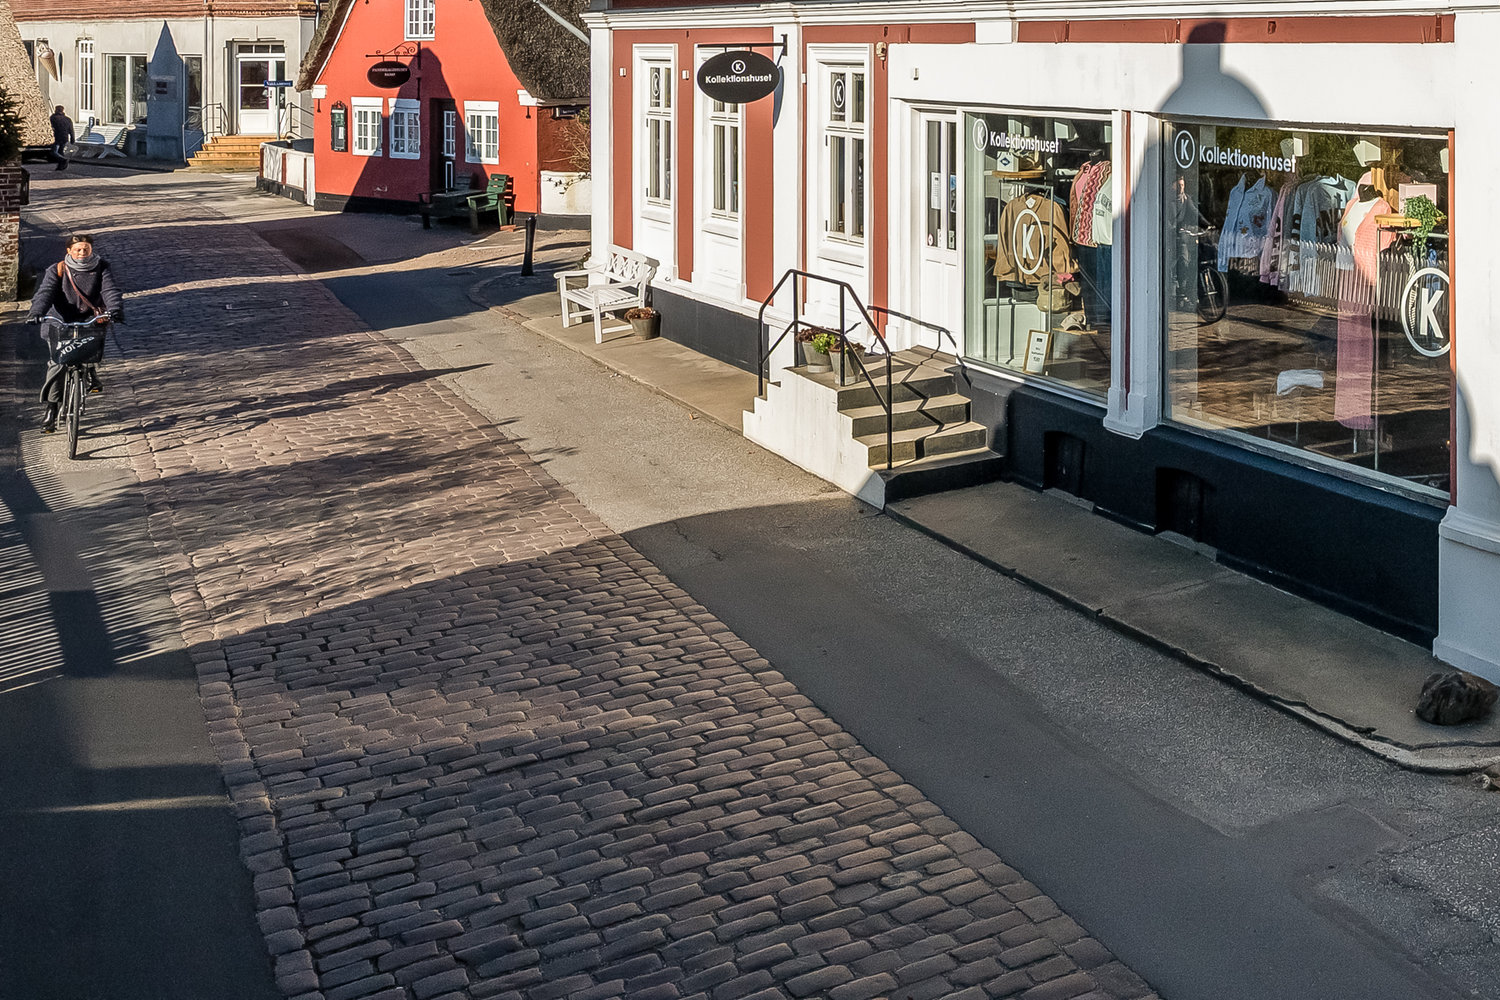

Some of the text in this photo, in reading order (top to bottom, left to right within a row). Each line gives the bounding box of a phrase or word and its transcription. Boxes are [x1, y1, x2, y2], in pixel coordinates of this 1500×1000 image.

[705, 74, 772, 83] Kollektionshuset
[836, 85, 842, 102] K
[977, 126, 1059, 153] K Kollektionshuset
[1181, 139, 1296, 173] K Kollektionshuset
[1022, 223, 1036, 260] K
[1420, 287, 1444, 339] K
